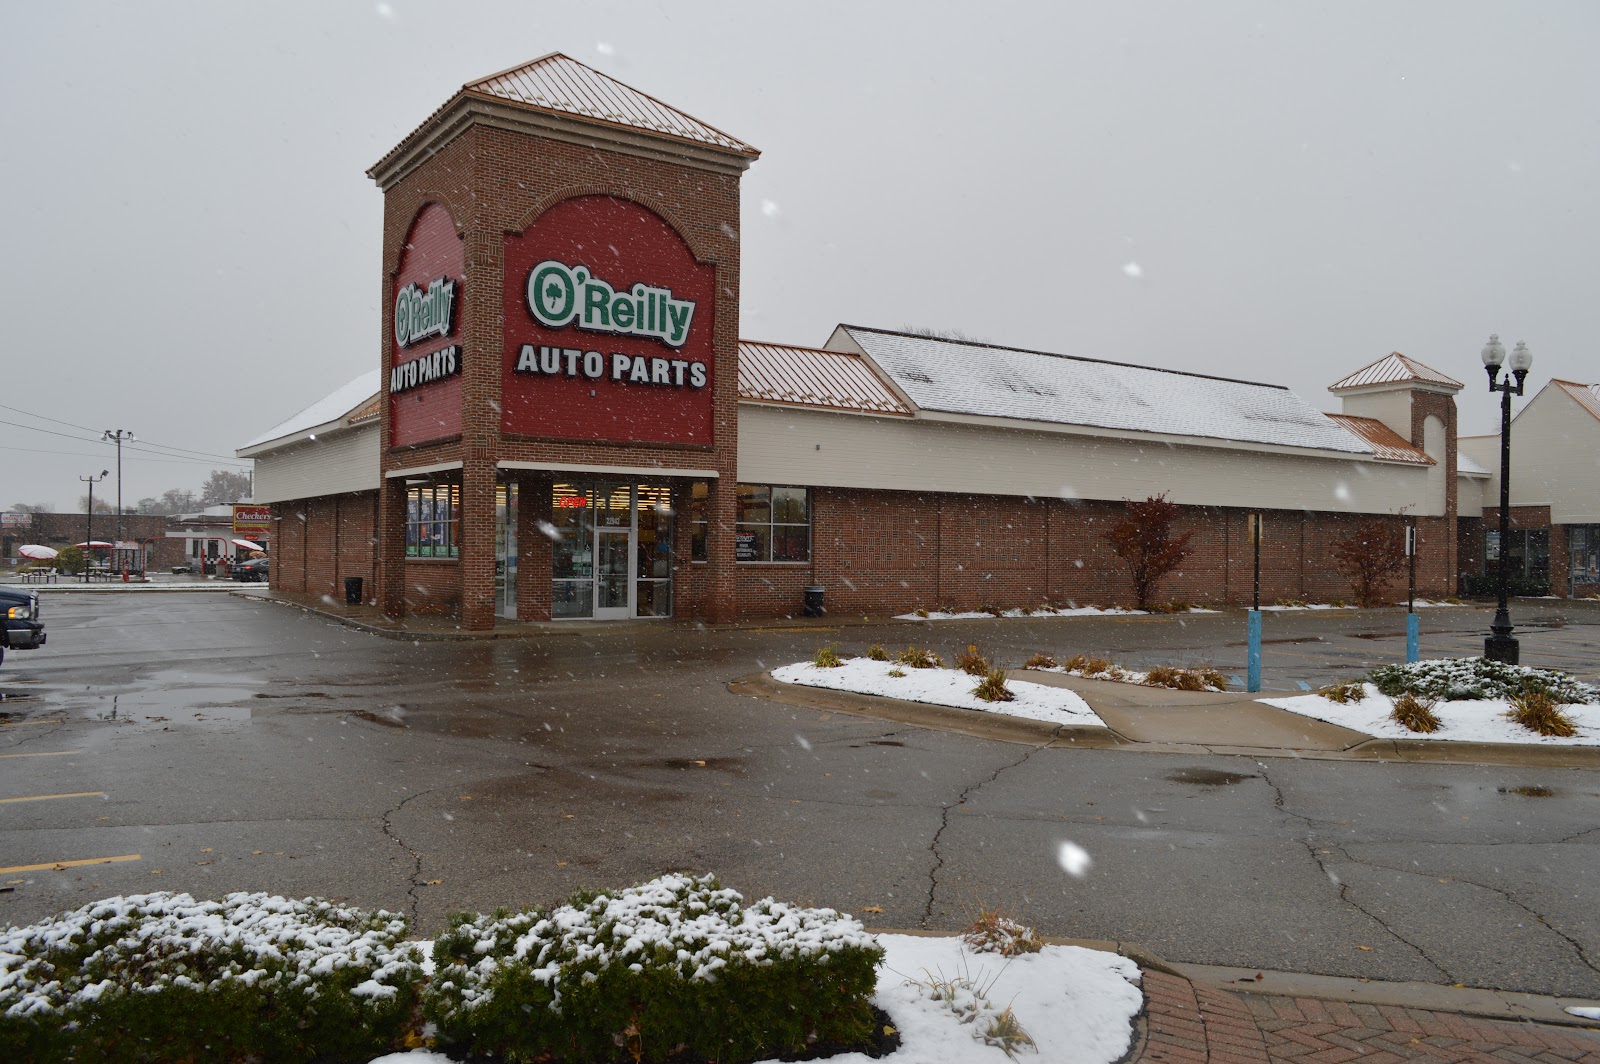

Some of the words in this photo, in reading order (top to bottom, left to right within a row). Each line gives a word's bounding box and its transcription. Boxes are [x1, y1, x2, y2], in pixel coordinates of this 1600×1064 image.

[395, 278, 453, 348] O'Reilly
[528, 261, 696, 346] O'Reilly
[390, 360, 417, 393] AUTO
[420, 346, 455, 383] PARTS
[517, 344, 603, 378] AUTO
[613, 353, 707, 388] PARTS
[236, 511, 271, 520] Checkers
[560, 496, 587, 508] OPEN
